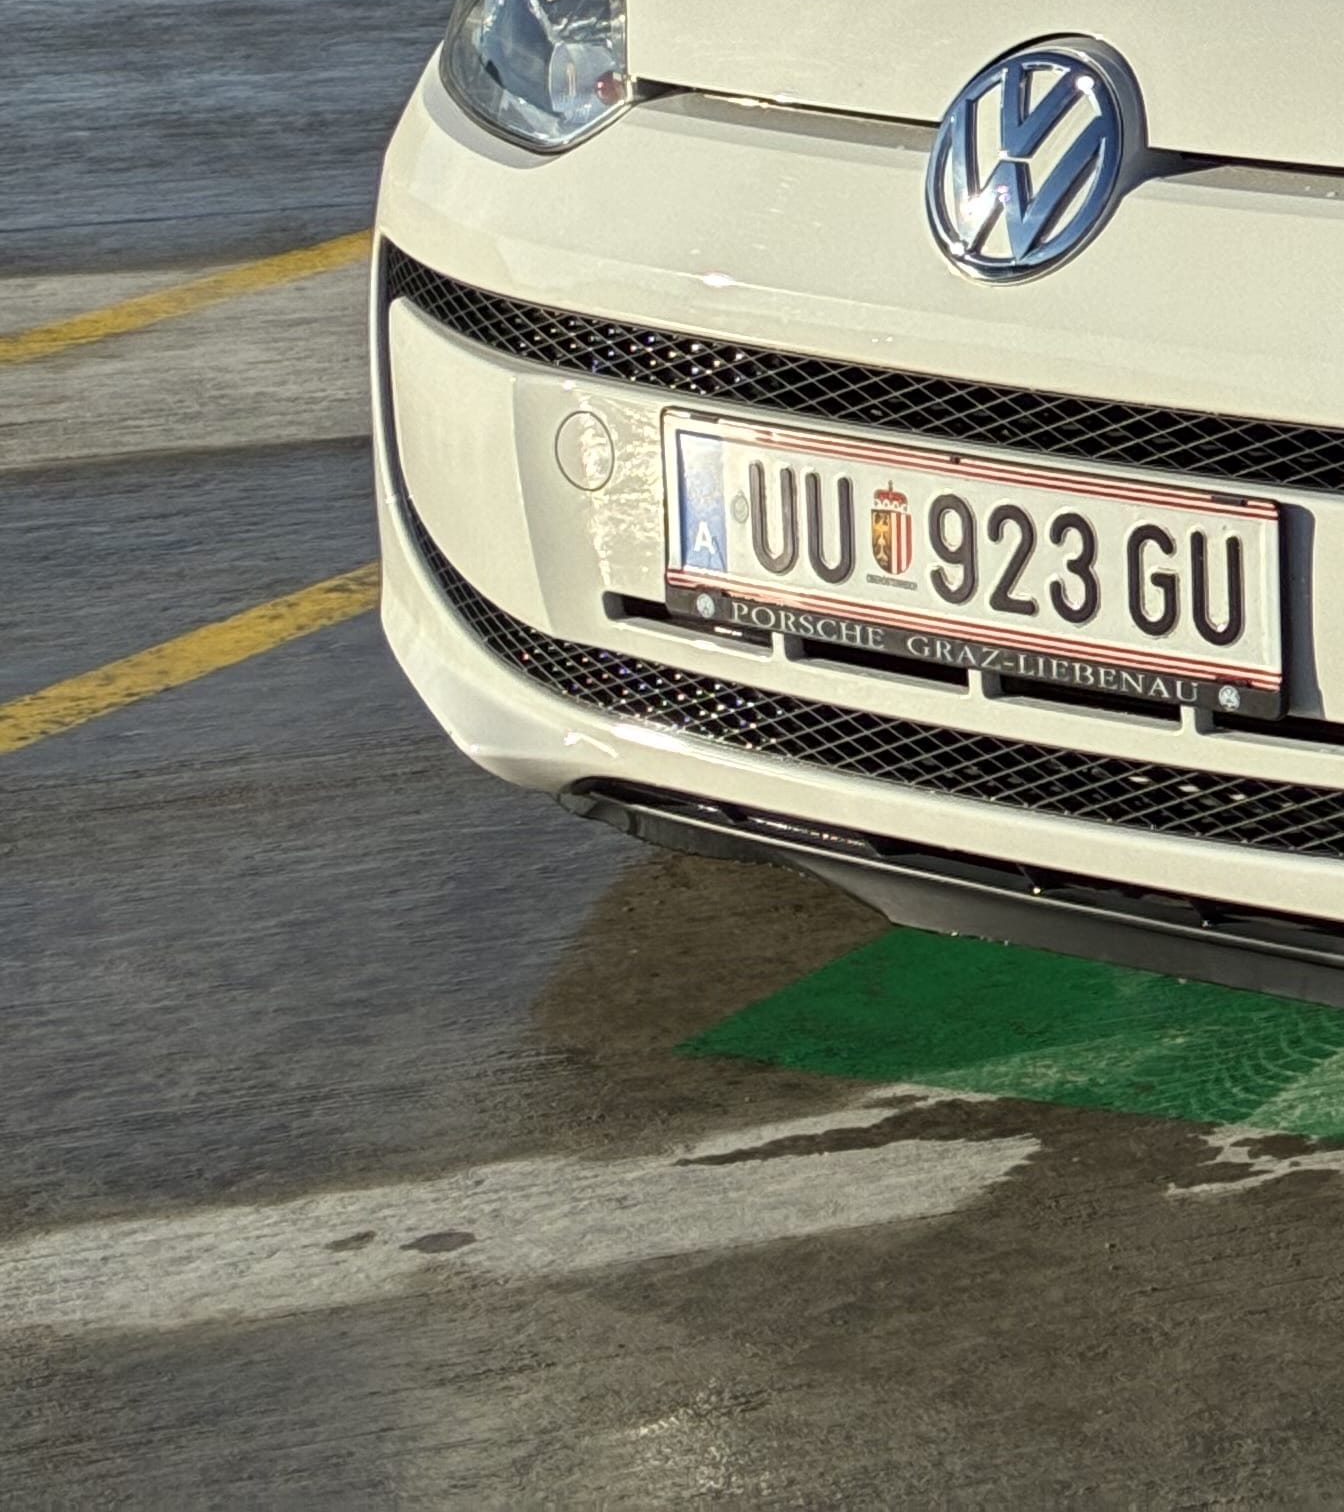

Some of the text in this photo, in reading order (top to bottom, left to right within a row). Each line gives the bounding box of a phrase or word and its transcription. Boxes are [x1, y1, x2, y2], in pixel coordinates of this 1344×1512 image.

[693, 520, 715, 554] A
[749, 460, 1246, 646] UU 923 GU
[731, 601, 1199, 703] PORSCHE GRAZ-LIEBENAU
